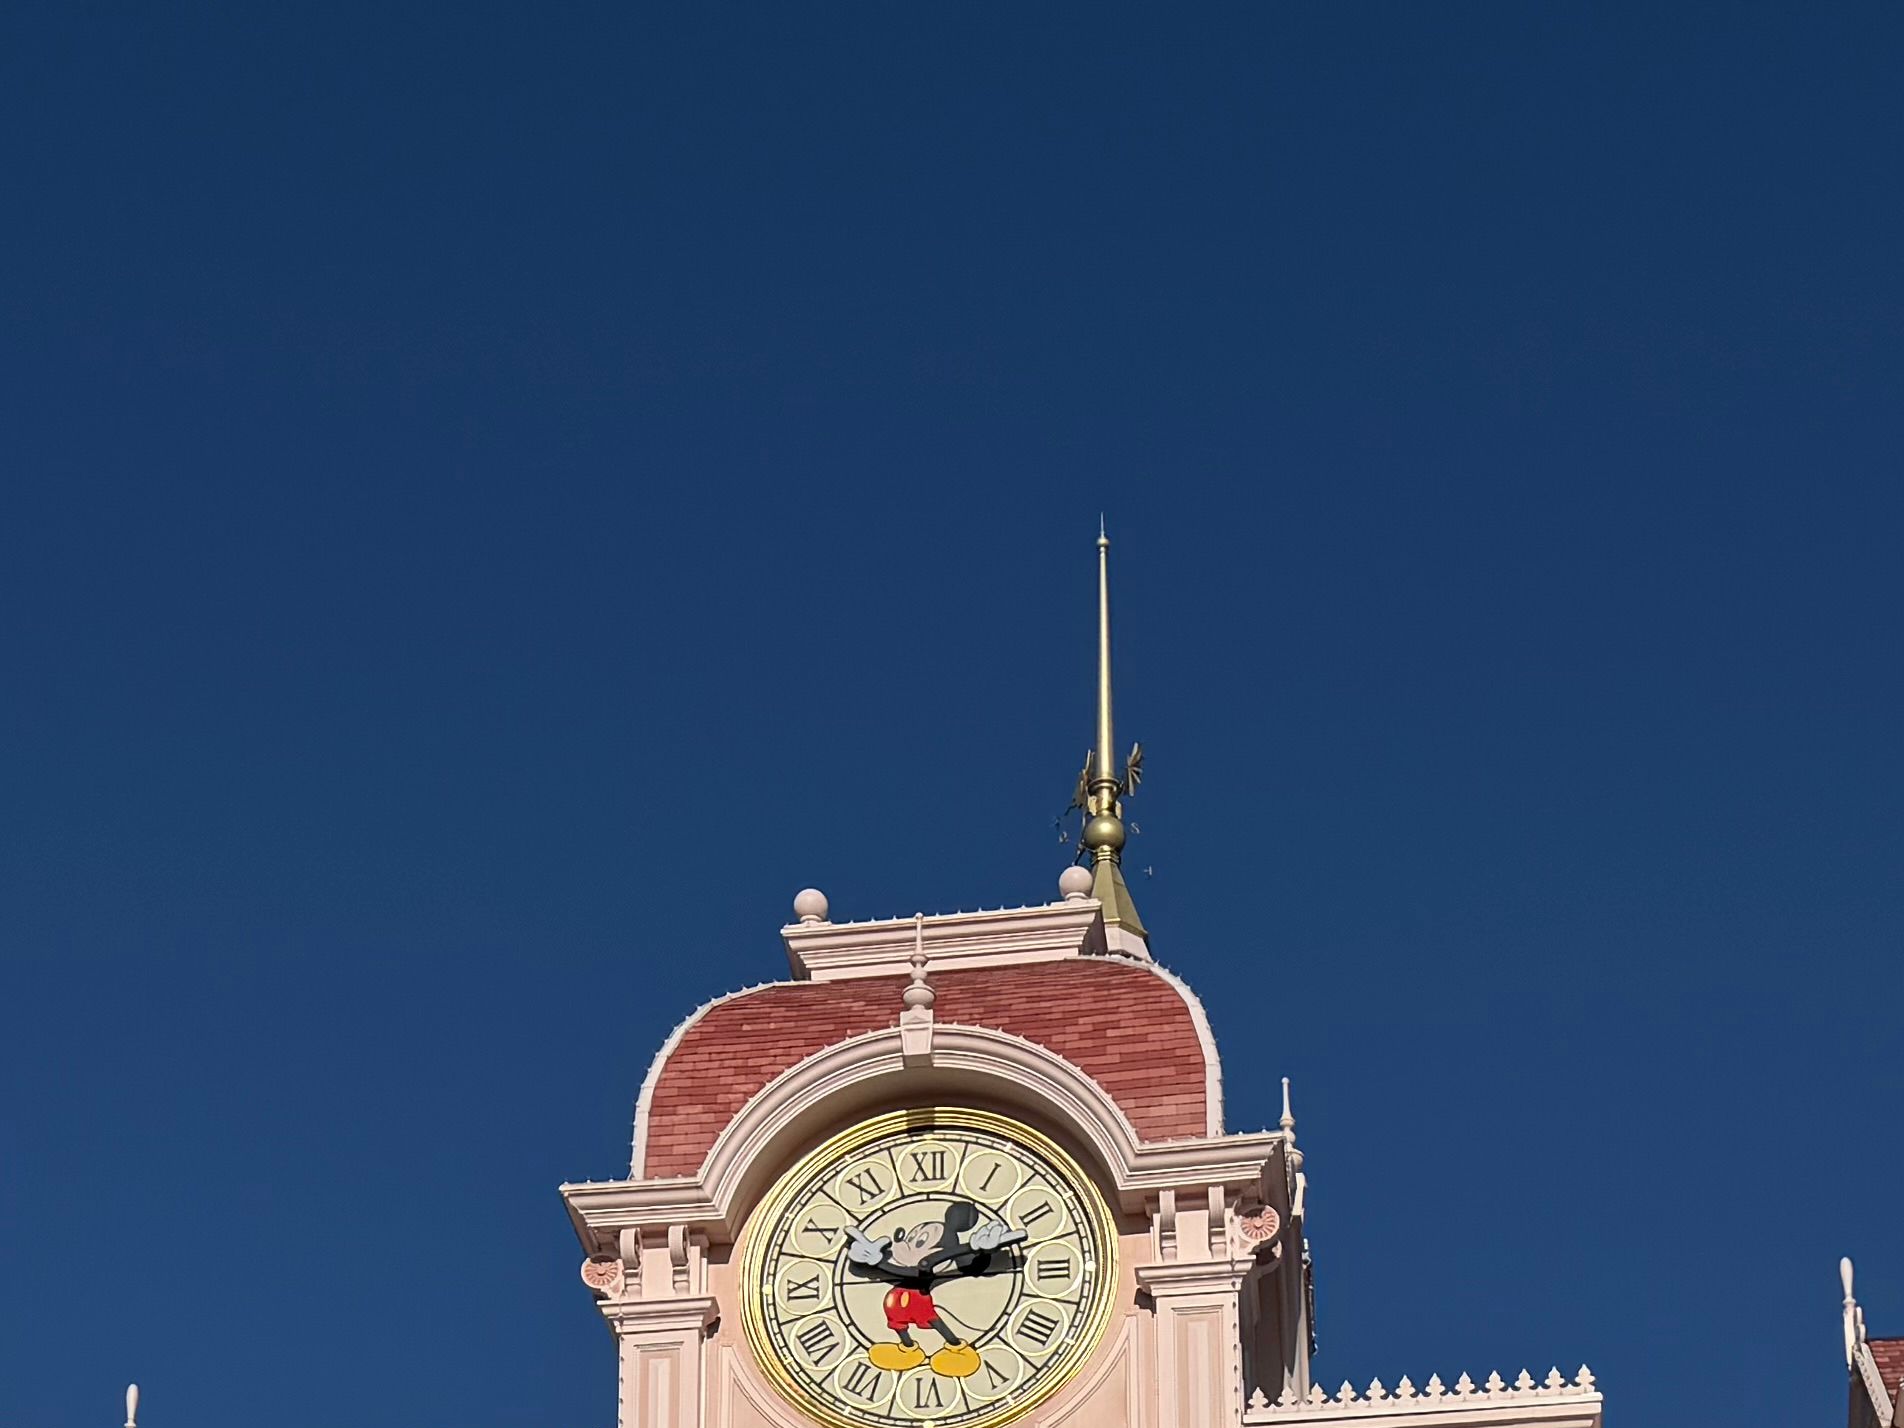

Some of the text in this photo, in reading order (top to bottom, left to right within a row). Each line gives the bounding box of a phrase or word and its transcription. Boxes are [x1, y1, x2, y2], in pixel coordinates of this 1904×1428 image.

[910, 1151, 946, 1182] XII
[980, 1163, 1001, 1191] I
[847, 1168, 885, 1205] XI
[1019, 1200, 1053, 1227] II
[803, 1217, 839, 1244] X
[1037, 1257, 1070, 1281] III
[842, 1362, 882, 1400] VII
[914, 1377, 944, 1408] VI
